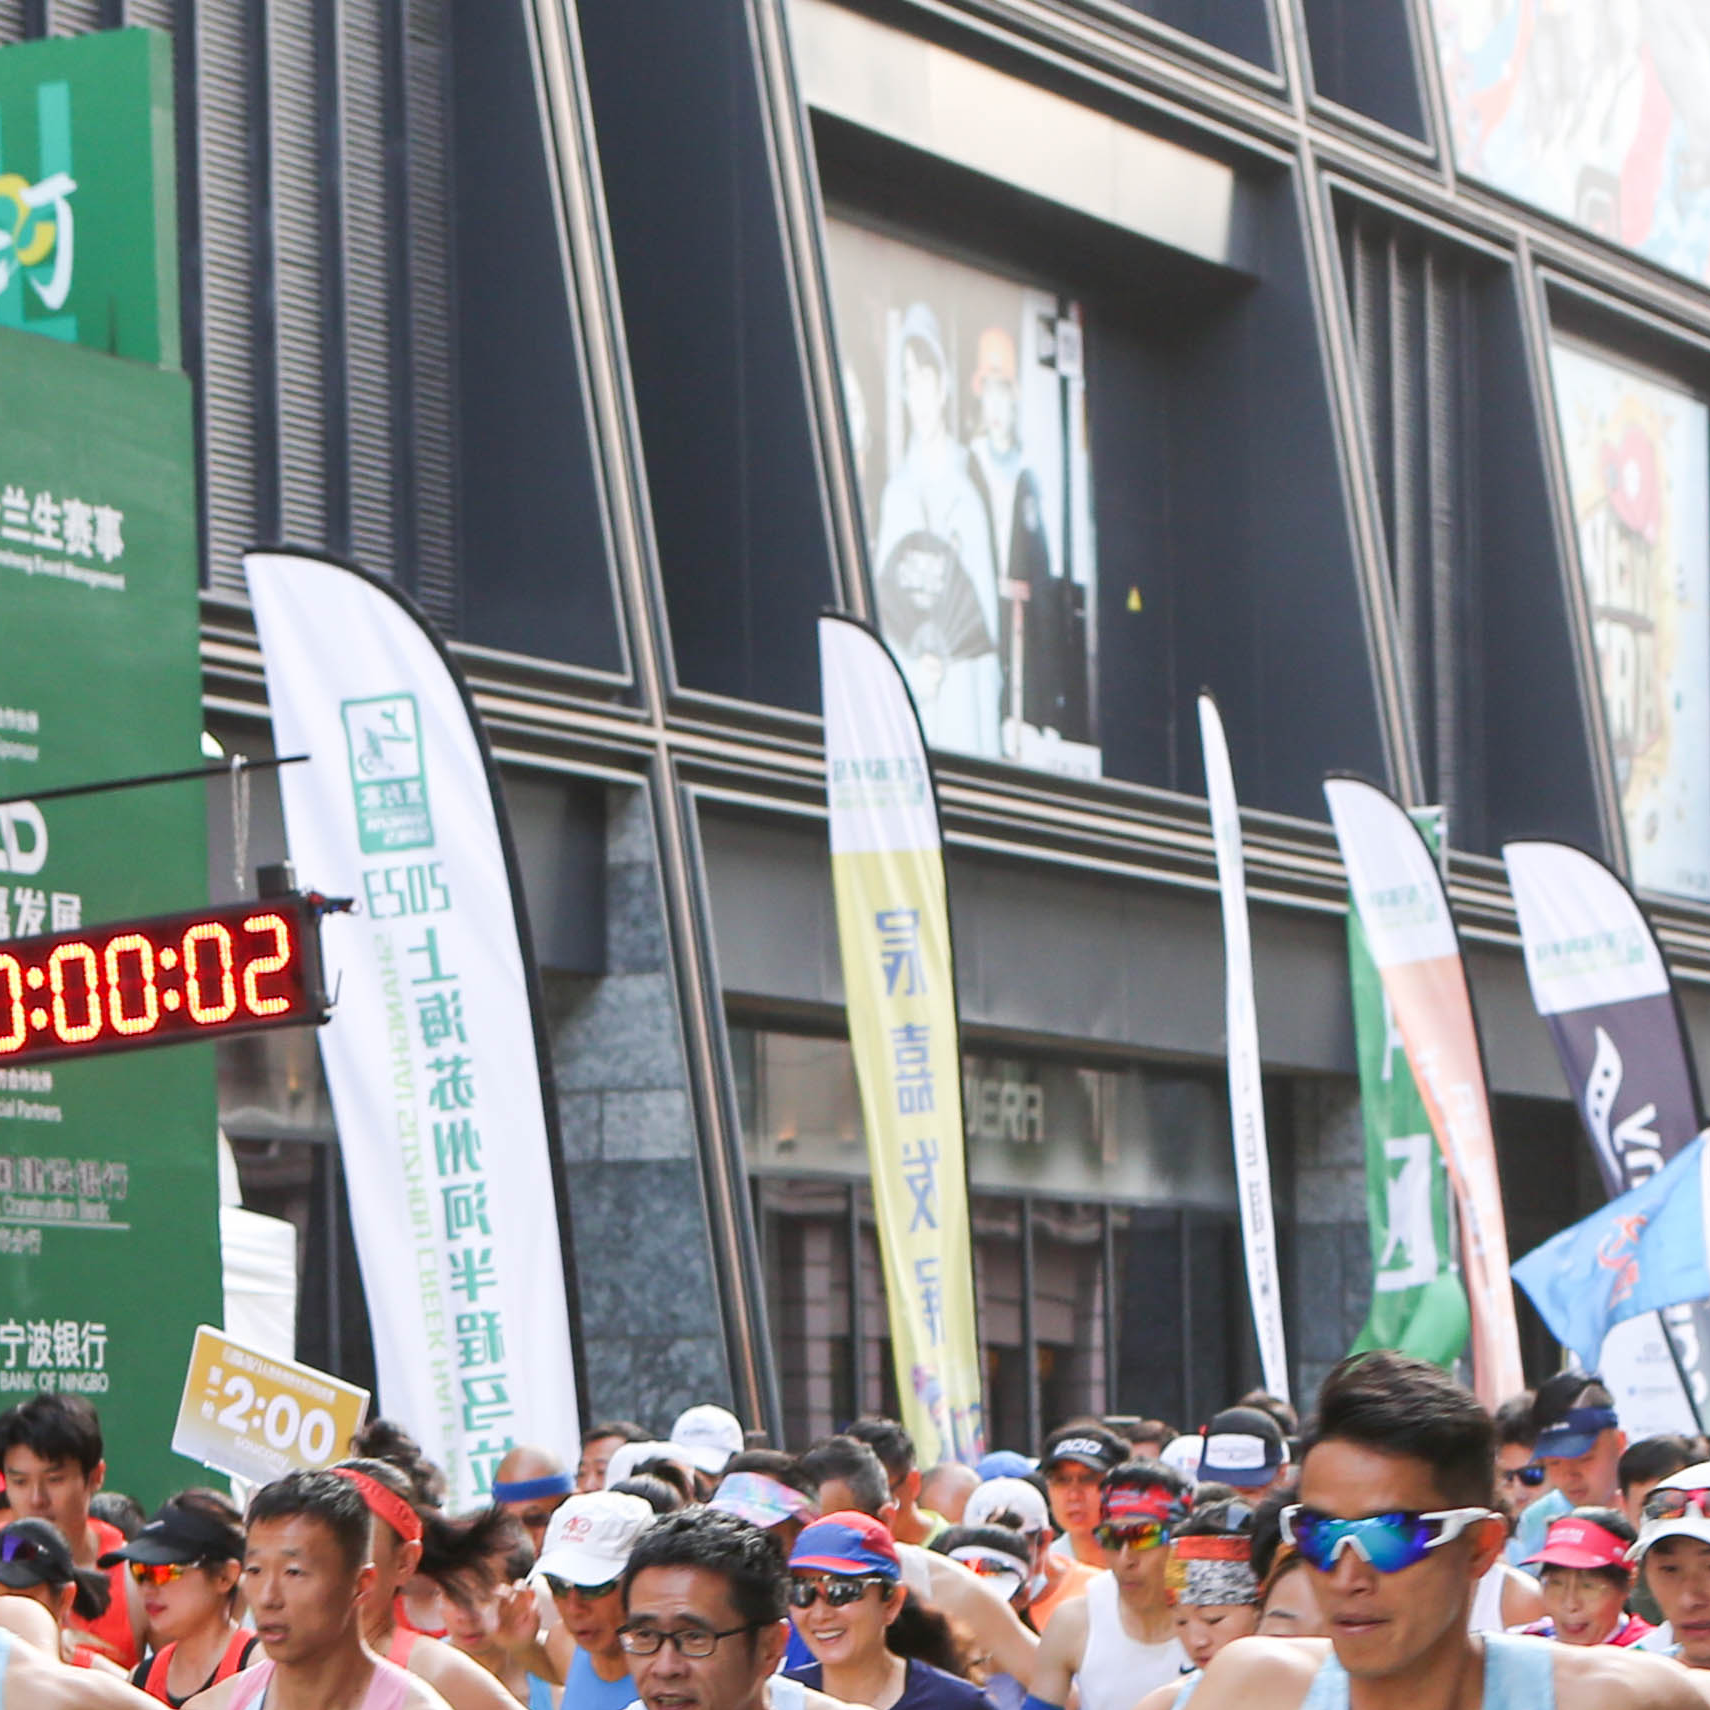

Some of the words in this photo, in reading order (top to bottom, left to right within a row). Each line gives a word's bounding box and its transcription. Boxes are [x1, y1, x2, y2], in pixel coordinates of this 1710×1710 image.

[17, 1099, 62, 1123] Partners
[37, 1372, 56, 1392] OF
[58, 1372, 109, 1394] NINGBO
[217, 1376, 336, 1465] 2:00
